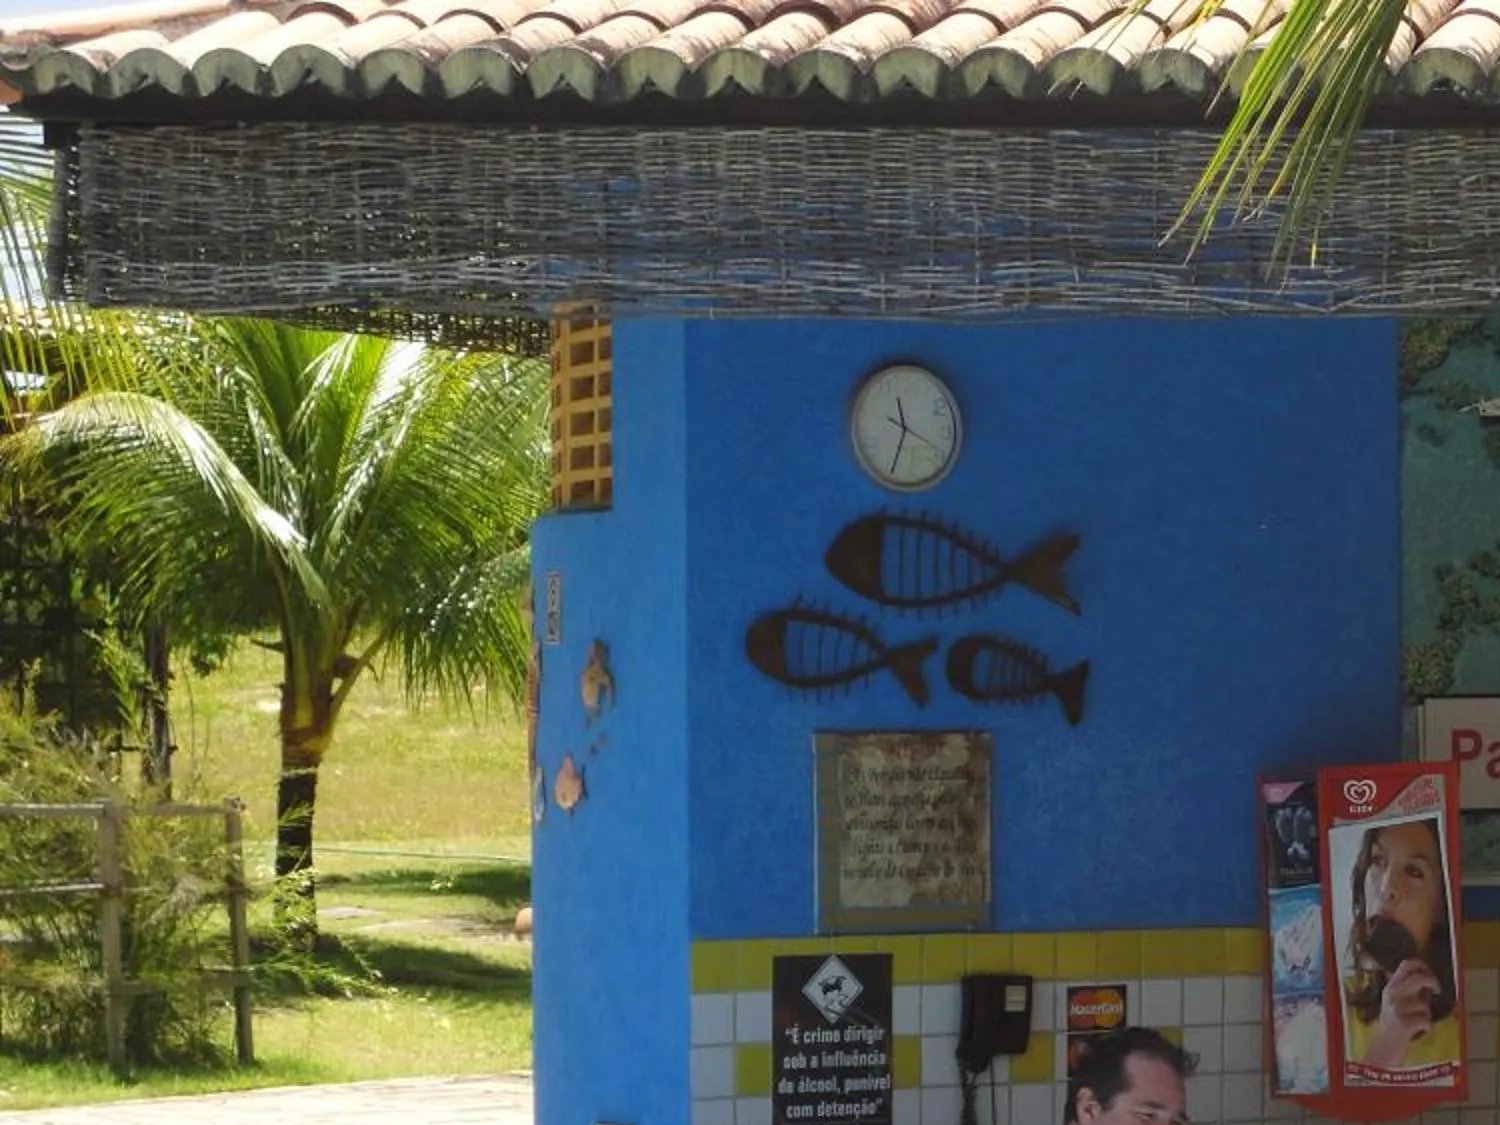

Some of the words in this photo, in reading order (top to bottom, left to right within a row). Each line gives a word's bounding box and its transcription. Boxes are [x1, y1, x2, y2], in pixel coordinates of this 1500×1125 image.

[804, 1026, 841, 1045] crime
[844, 1024, 885, 1046] dirigir
[810, 1056, 819, 1069] a
[778, 1078, 795, 1094] de
[786, 1104, 814, 1119] com
